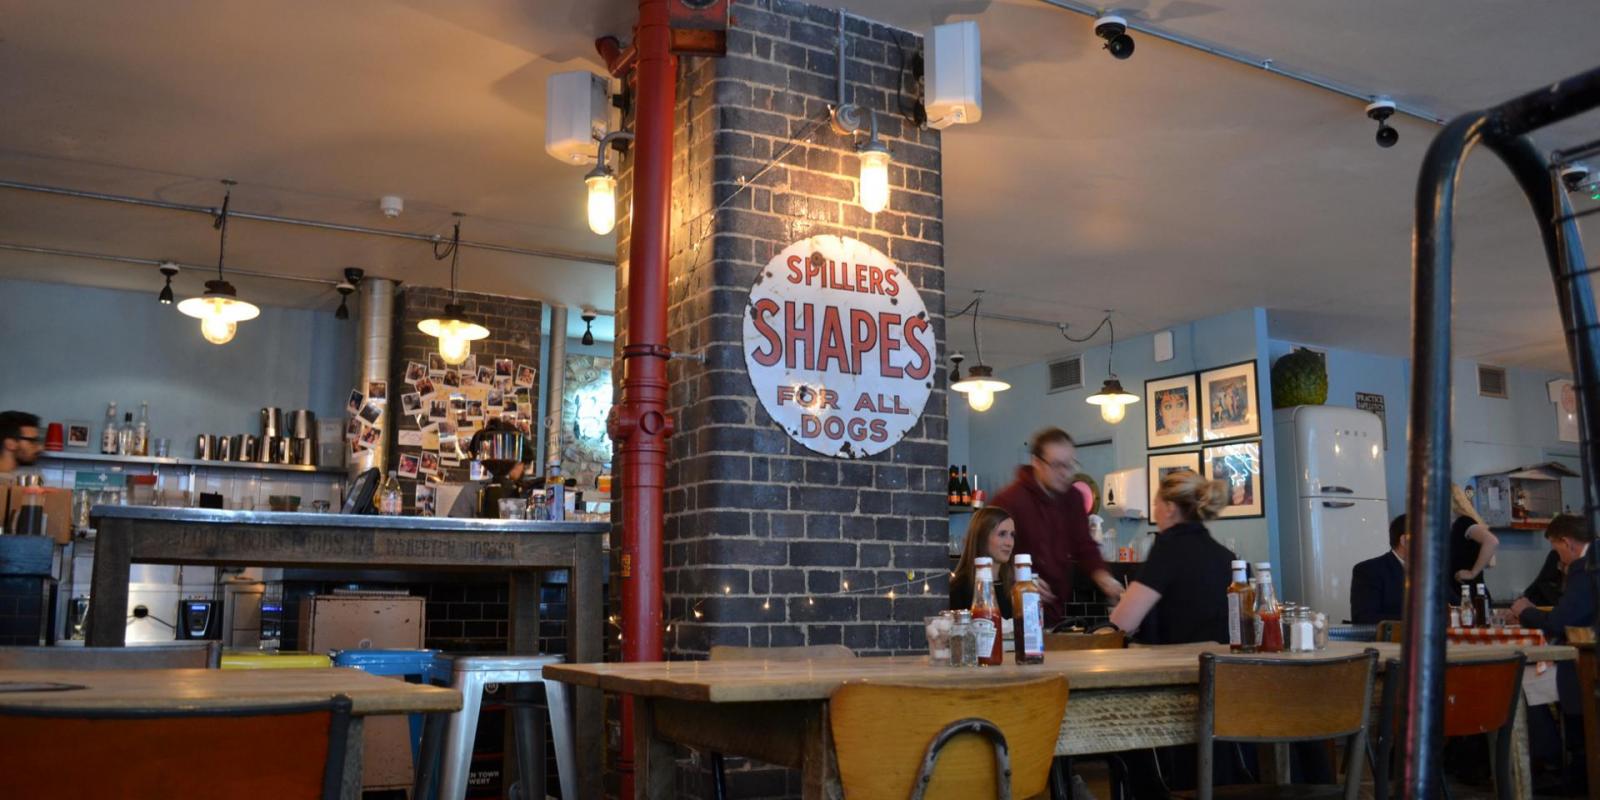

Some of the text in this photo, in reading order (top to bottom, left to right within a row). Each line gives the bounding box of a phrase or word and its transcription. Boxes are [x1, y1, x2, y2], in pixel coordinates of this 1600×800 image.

[786, 254, 900, 297] SPILLERS
[751, 298, 932, 381] SHAPES
[777, 385, 911, 415] FOR ALL
[801, 413, 889, 443] DOGS
